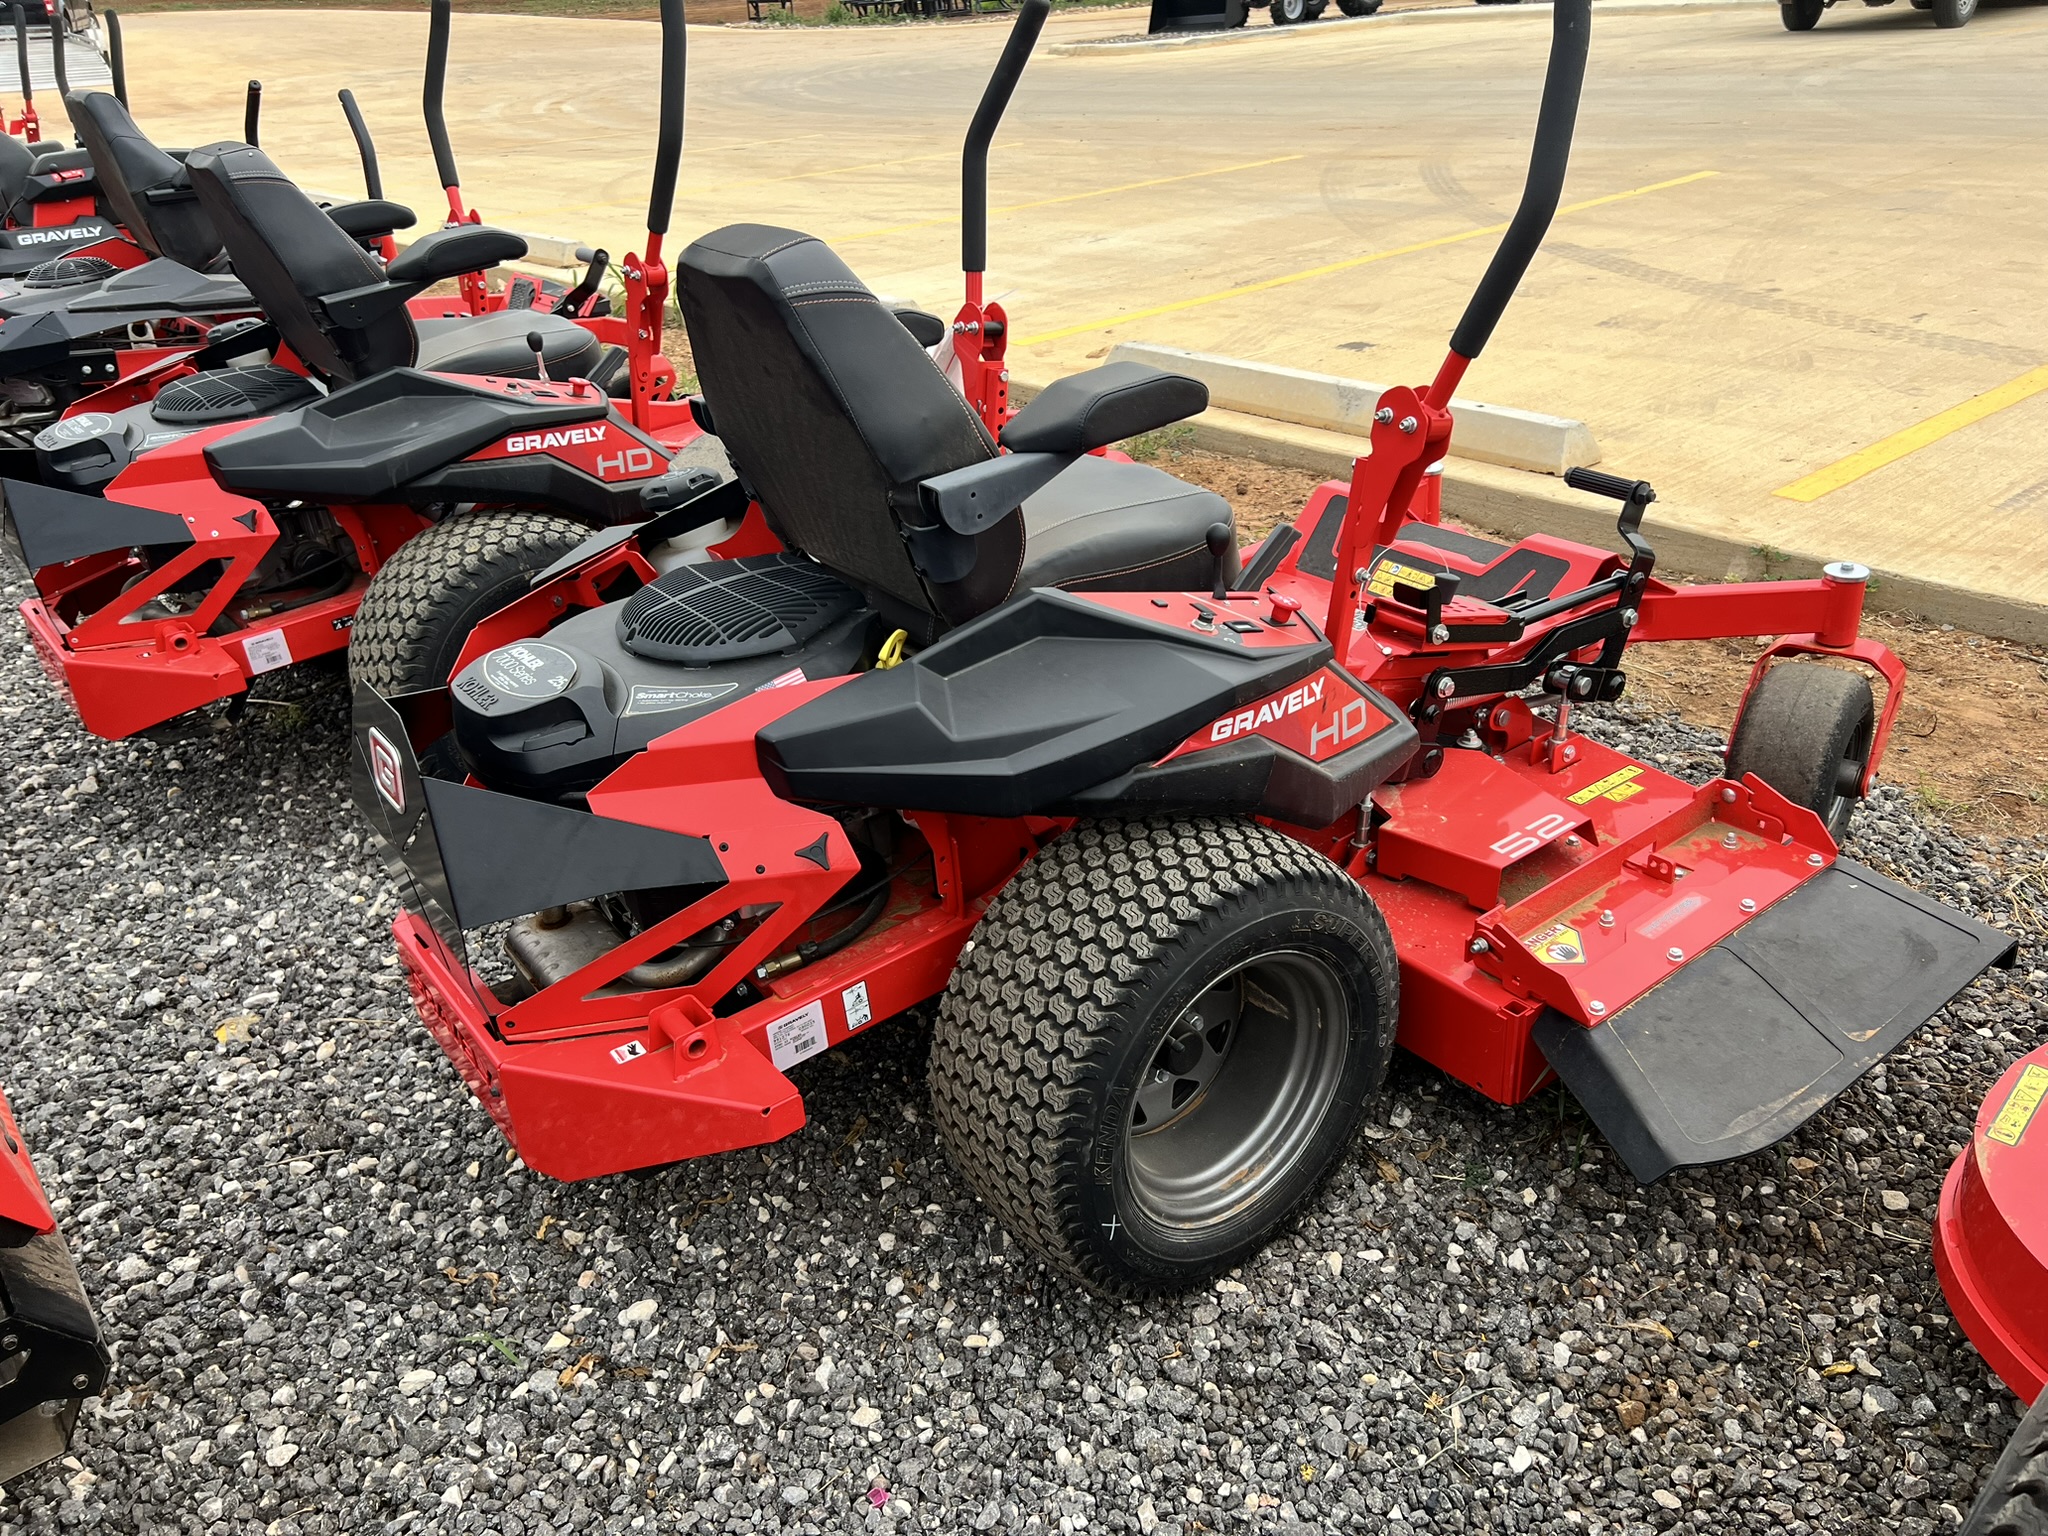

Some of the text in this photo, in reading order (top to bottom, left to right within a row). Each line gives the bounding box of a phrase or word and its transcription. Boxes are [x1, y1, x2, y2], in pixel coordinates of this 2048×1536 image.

[16, 225, 103, 246] GRAVELY
[506, 425, 607, 453] GRAVELY
[596, 447, 654, 477] HD
[492, 652, 513, 673] 7000
[510, 664, 537, 686] Series
[508, 646, 545, 671] KOHLER
[456, 676, 499, 712] KOHLER
[635, 691, 713, 700] SmartChoke
[1210, 675, 1326, 742] GRAVELY
[1309, 697, 1367, 756] HD
[1489, 812, 1577, 859] 52
[1310, 911, 1377, 963] SUPER
[1523, 926, 1562, 949] ANGER
[1094, 1086, 1131, 1186] KENDA
